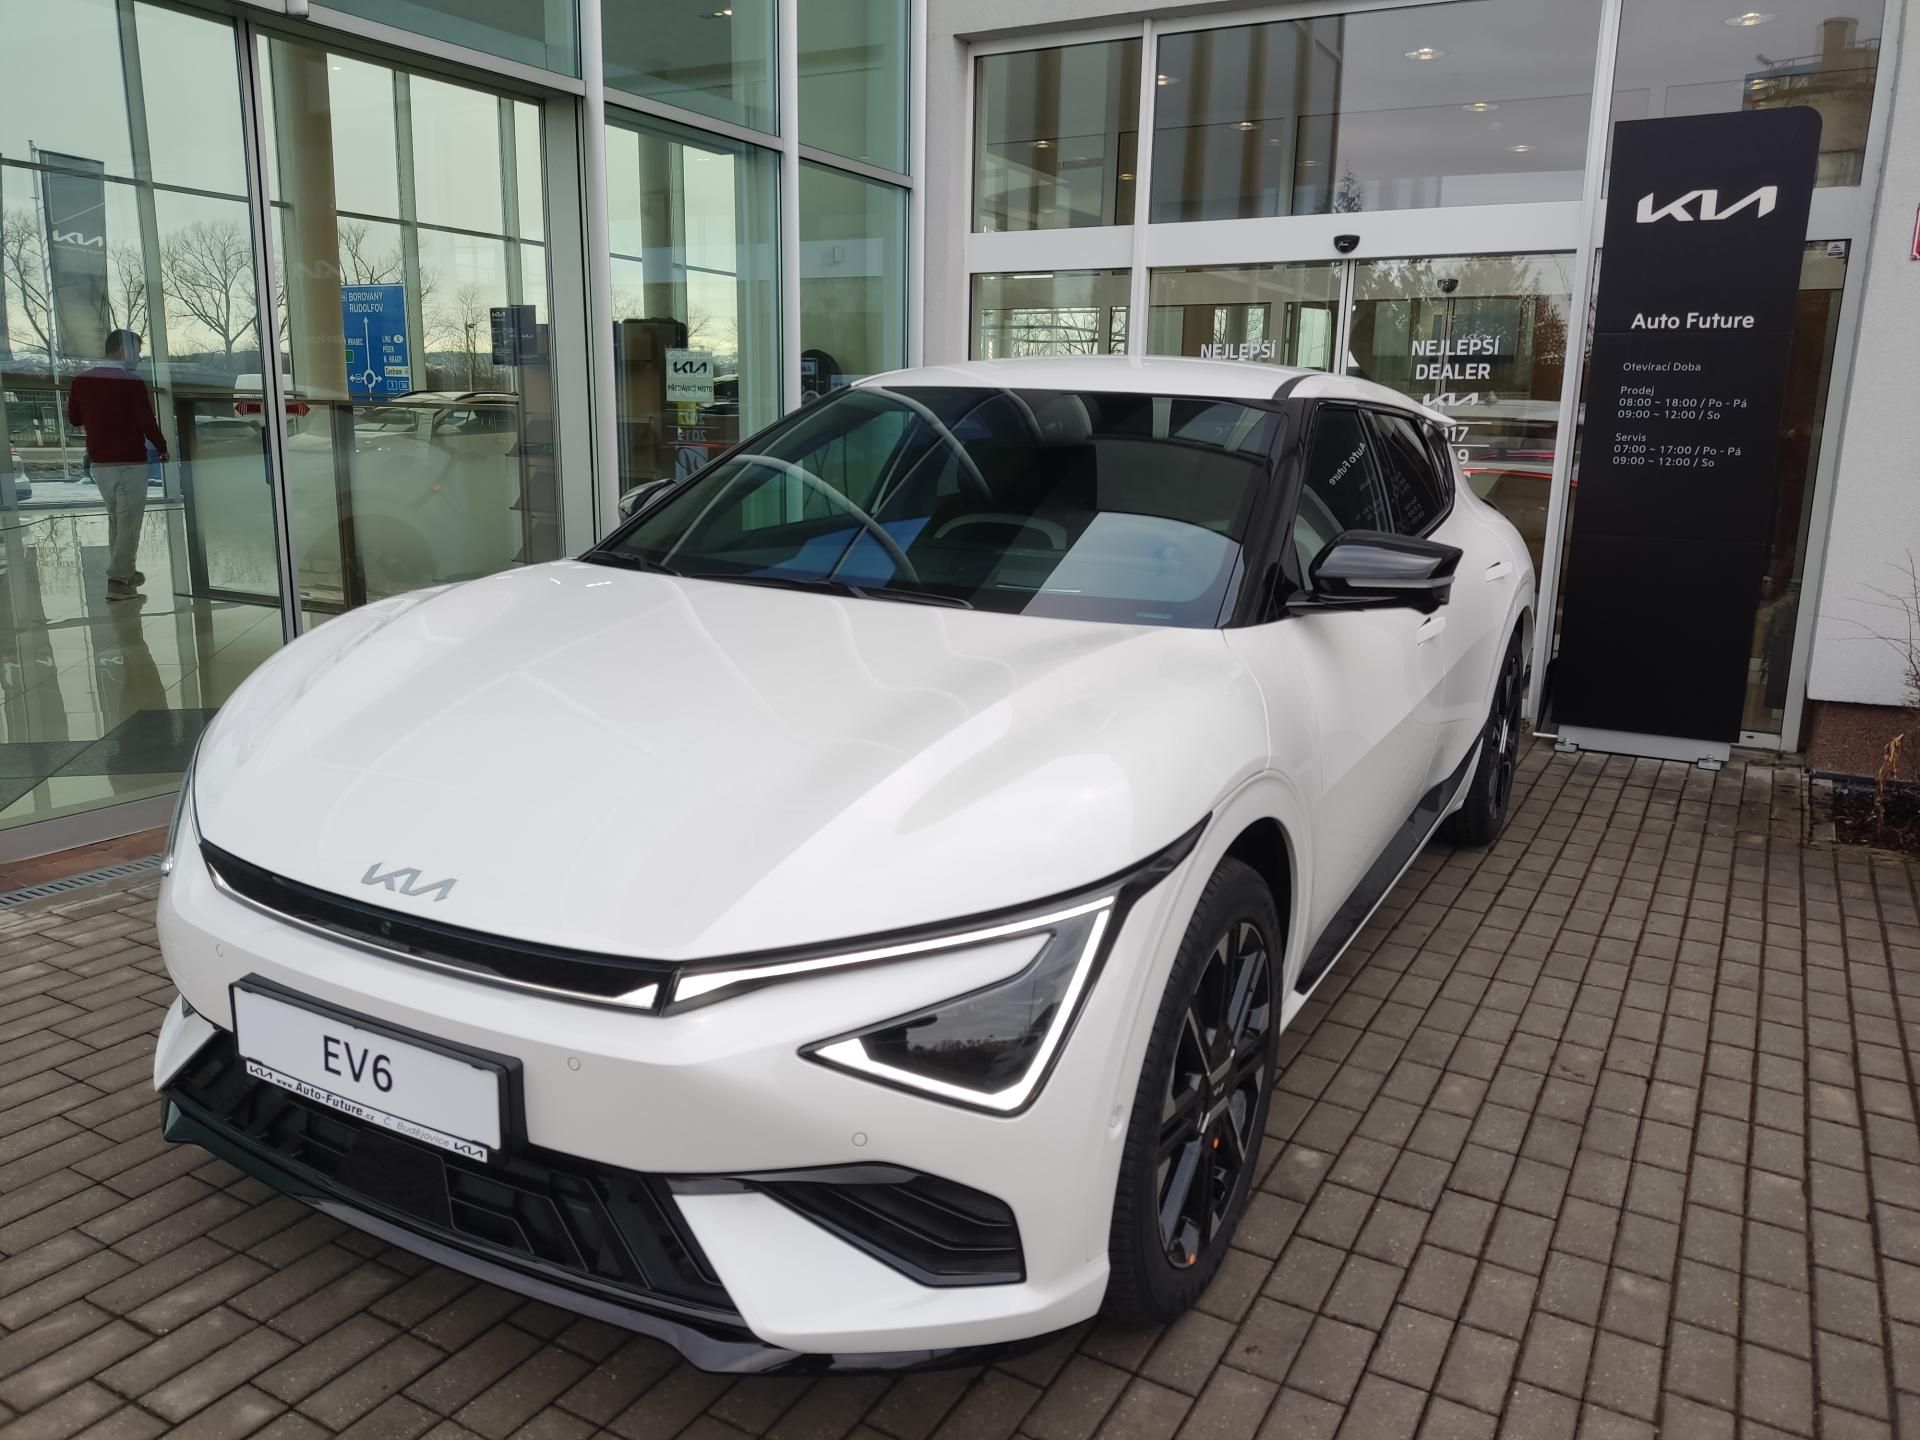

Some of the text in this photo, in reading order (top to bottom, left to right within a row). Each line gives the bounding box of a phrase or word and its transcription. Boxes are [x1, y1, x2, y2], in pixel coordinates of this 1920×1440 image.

[1636, 185, 1778, 223] KIA
[53, 230, 103, 248] KIA
[349, 292, 383, 301] BOROVANY
[349, 304, 384, 313] RUDOLFOV
[1630, 312, 1755, 330] Auto Future
[1200, 340, 1277, 359] NEJLEPŠÍ
[1411, 335, 1500, 356] NEJLEPŠÍ
[673, 361, 708, 374] KIA
[1415, 363, 1491, 380] DEALER
[1623, 362, 1702, 372] Otevírací Doba
[667, 384, 713, 393] PŘEDÁVACÍ MÍSTO
[1620, 385, 1655, 397] Prodej
[1423, 392, 1479, 406] KIA
[1619, 398, 1652, 407] 08:00
[1665, 398, 1697, 408] 18:00
[1708, 398, 1723, 408] Po
[1733, 399, 1748, 408] Pá
[1618, 410, 1650, 419] 09:00
[1664, 410, 1696, 420] 12:00
[1707, 410, 1721, 420] So
[1615, 432, 1647, 442] Servis
[1614, 444, 1646, 454] 07:00
[1660, 445, 1692, 455] 17:00
[1702, 446, 1717, 455] Po
[1727, 447, 1742, 456] Pá
[1612, 456, 1645, 465] 09:00
[1659, 457, 1690, 466] 12:00
[1701, 458, 1715, 468] So
[361, 862, 459, 902] KIA
[323, 1034, 393, 1093] EV6
[250, 1065, 273, 1080] KIA
[396, 1120, 450, 1148] Budějovice
[455, 1141, 483, 1158] KIA
